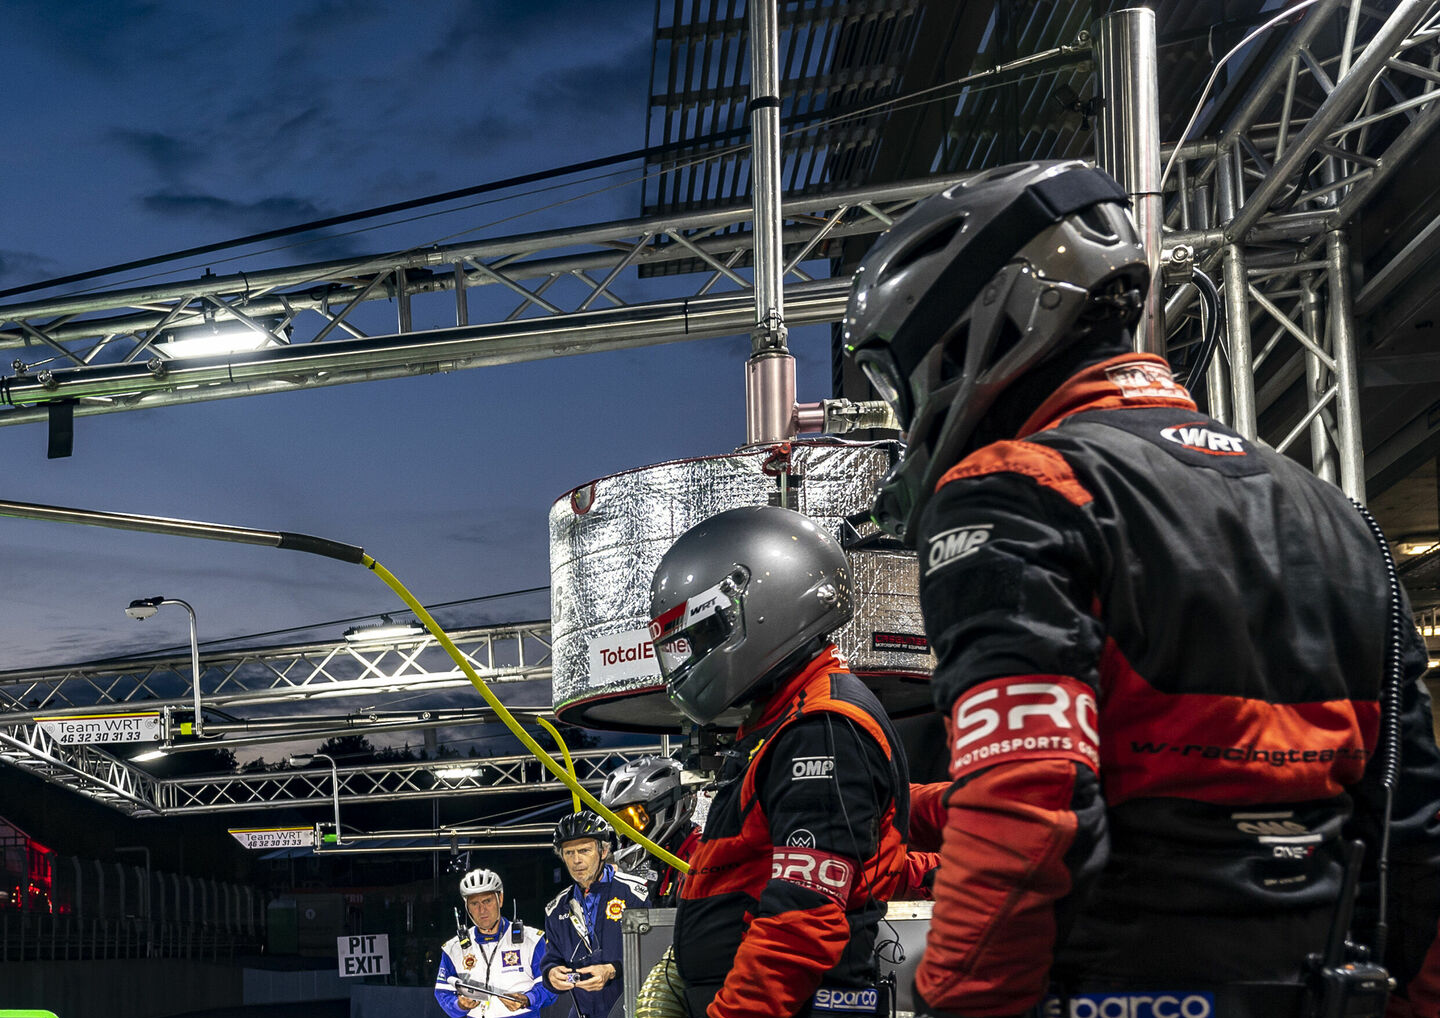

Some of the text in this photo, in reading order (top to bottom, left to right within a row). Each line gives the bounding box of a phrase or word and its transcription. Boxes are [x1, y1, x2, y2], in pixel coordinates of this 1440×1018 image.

[1178, 427, 1244, 453] WRT
[928, 529, 990, 568] OMP
[690, 597, 718, 617] WRT
[58, 718, 143, 733] Team WRT
[60, 731, 141, 743] 46 32 30 31 33
[792, 760, 834, 777] OMP
[245, 831, 302, 841] Team WRT
[349, 936, 376, 954] PIT
[344, 955, 383, 974] EXIT
[816, 989, 877, 1008] sparco
